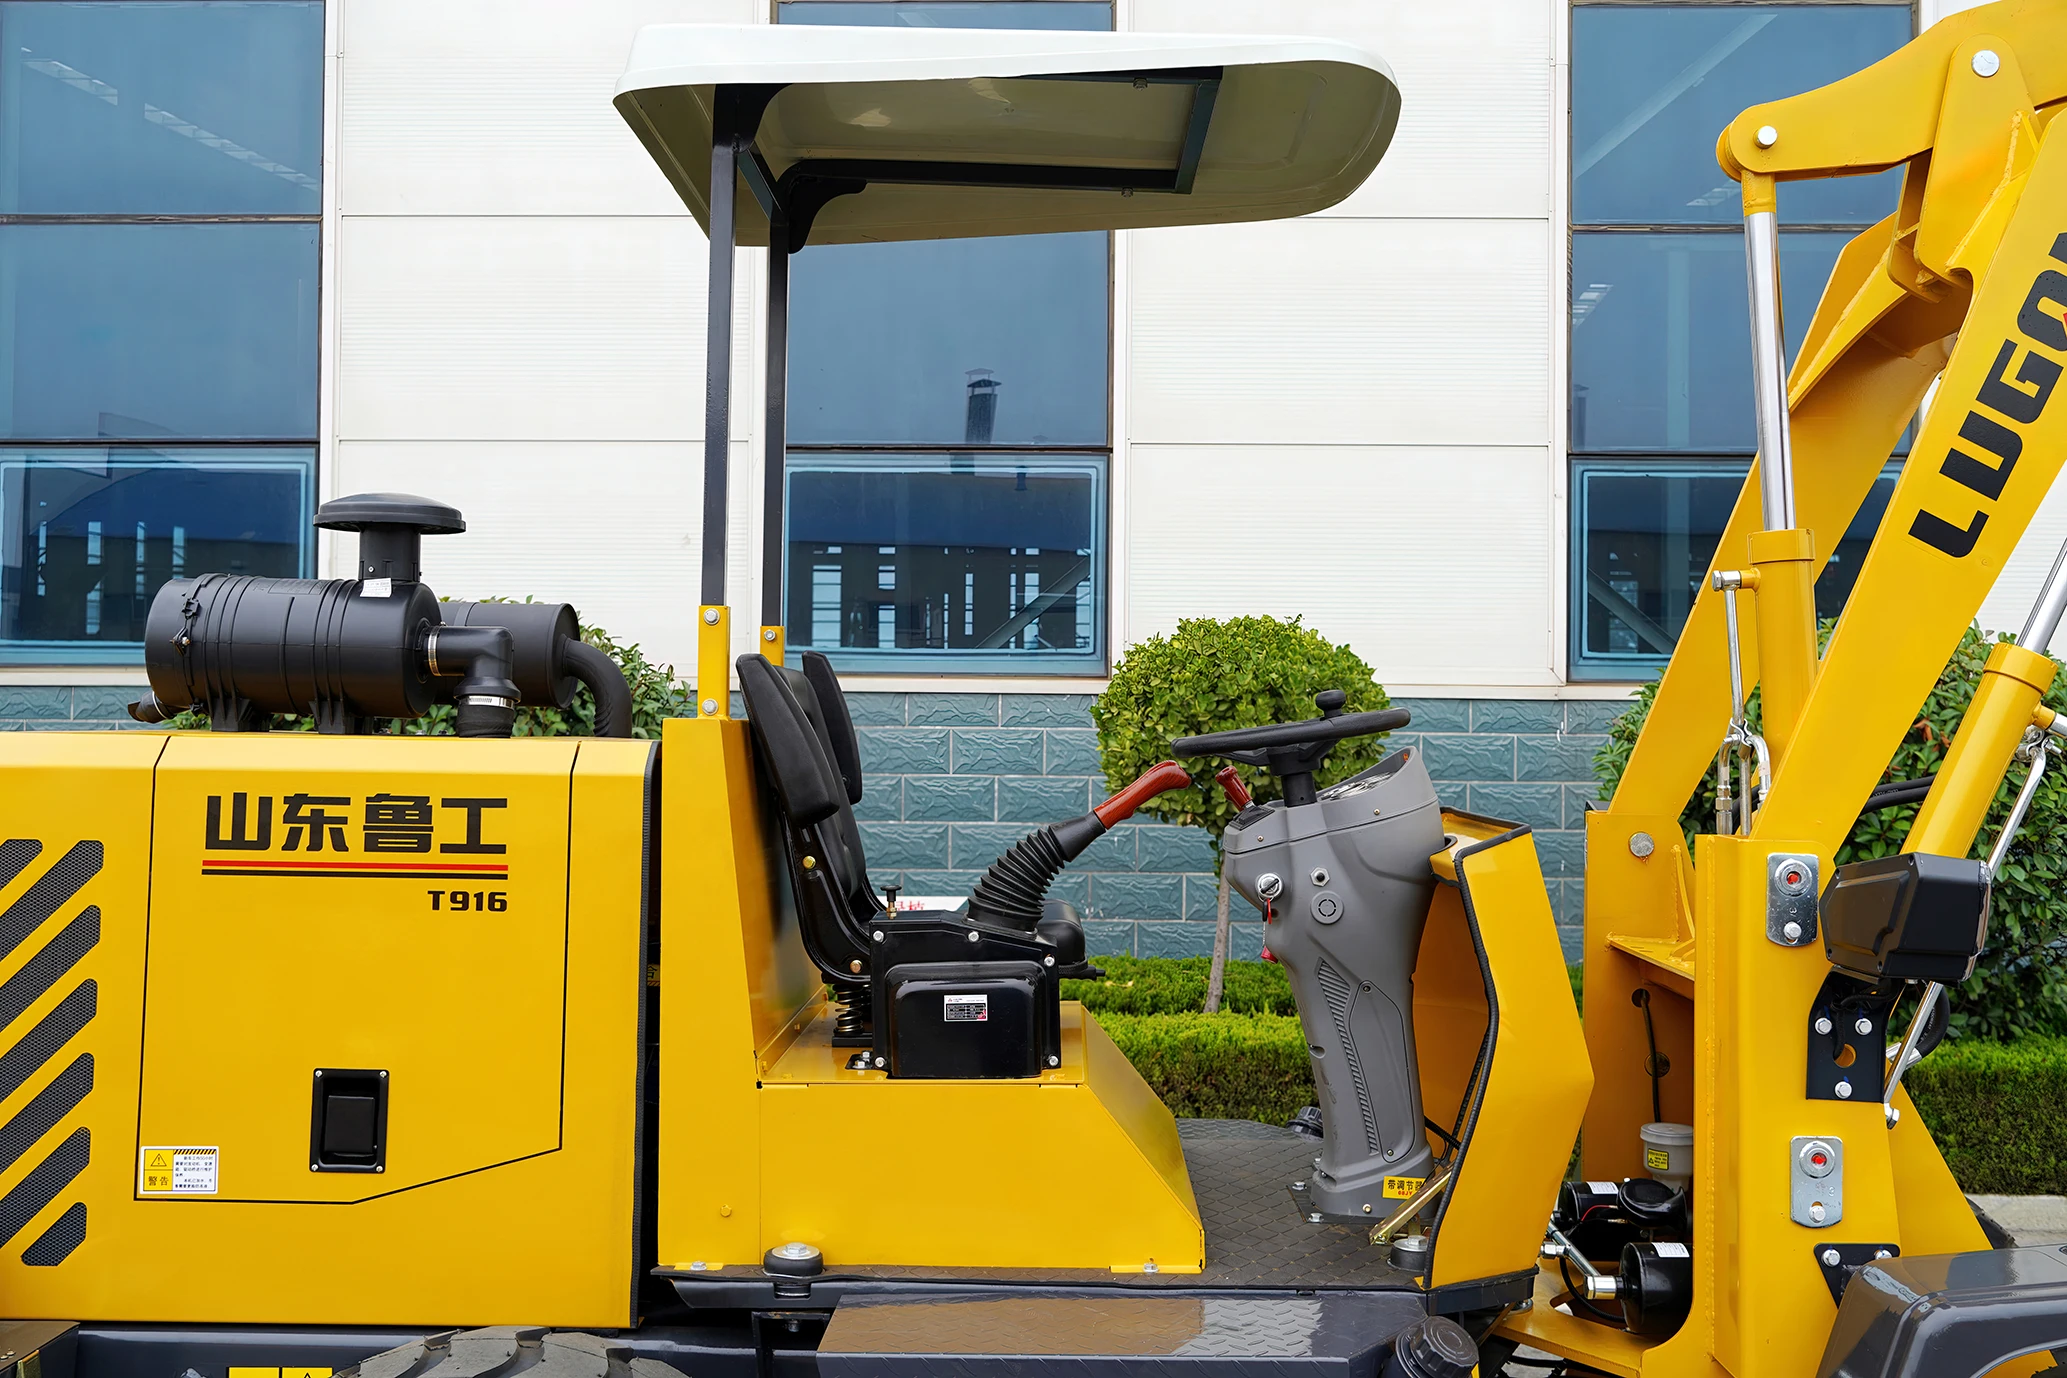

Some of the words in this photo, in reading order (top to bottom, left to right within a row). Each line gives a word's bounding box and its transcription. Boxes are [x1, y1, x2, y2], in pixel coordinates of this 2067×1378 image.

[1908, 232, 2067, 558] LUGO
[204, 791, 508, 855] 山东鲁工
[427, 890, 508, 912] T916
